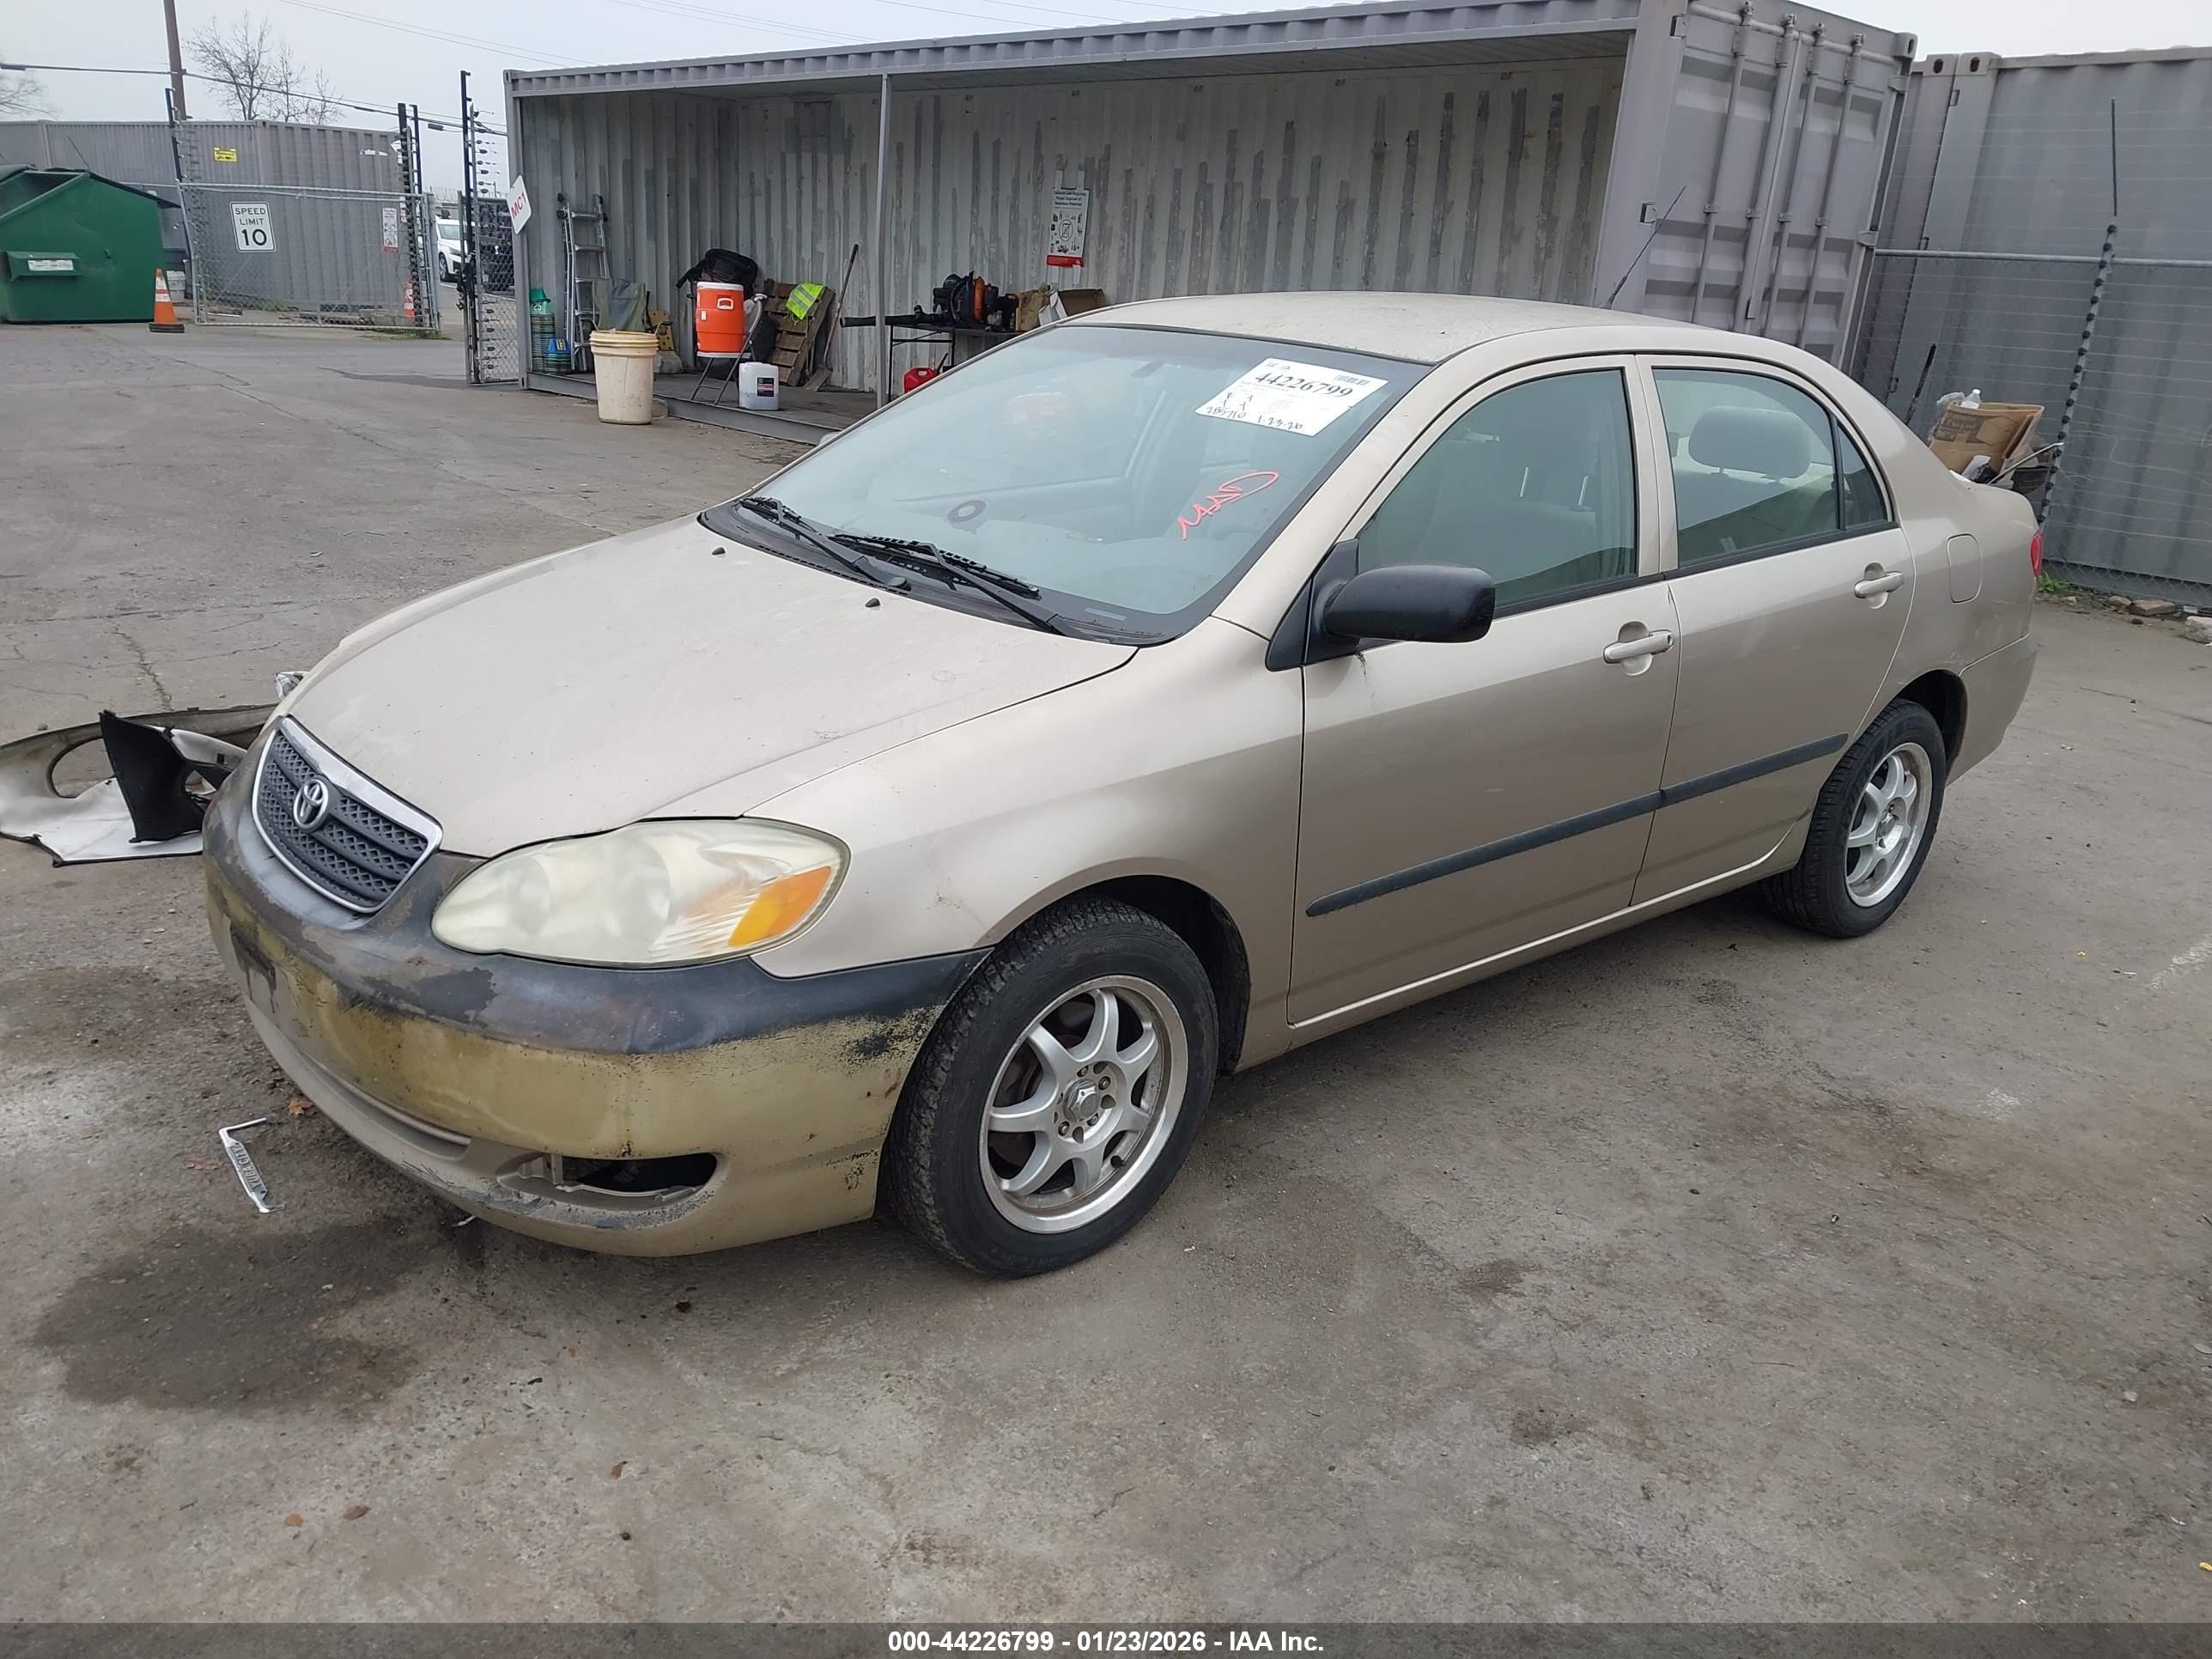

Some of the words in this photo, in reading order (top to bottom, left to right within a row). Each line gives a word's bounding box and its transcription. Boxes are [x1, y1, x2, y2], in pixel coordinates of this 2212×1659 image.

[511, 191, 526, 220] MC1
[241, 228, 267, 246] 10
[533, 301, 542, 311] 25
[1255, 373, 1353, 397] 44226799
[232, 1145, 250, 1165] CITY
[243, 1165, 262, 1190] YUBA
